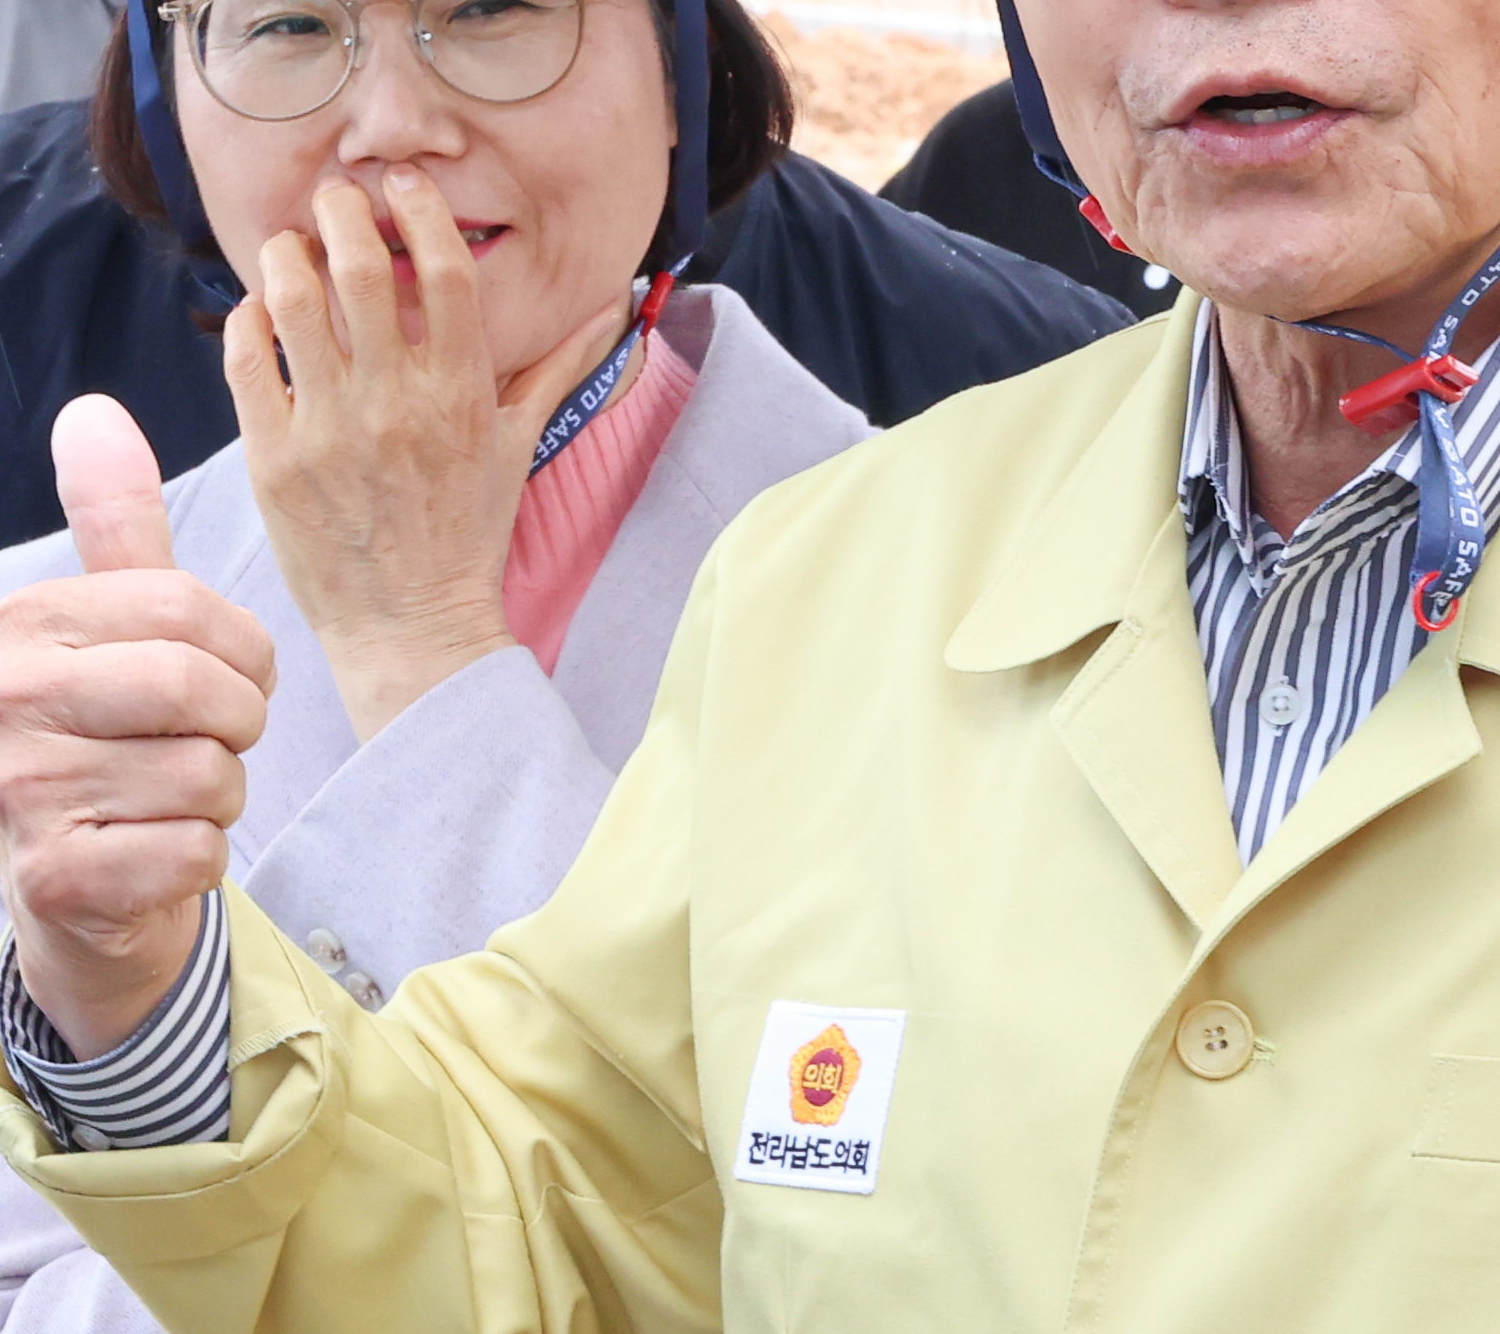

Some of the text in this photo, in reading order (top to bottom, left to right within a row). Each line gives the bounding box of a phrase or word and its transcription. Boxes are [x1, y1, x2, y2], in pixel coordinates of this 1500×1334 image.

[532, 408, 582, 467] SAFE
[802, 1061, 843, 1094] 의회
[748, 1132, 870, 1175] 전라남도의회
